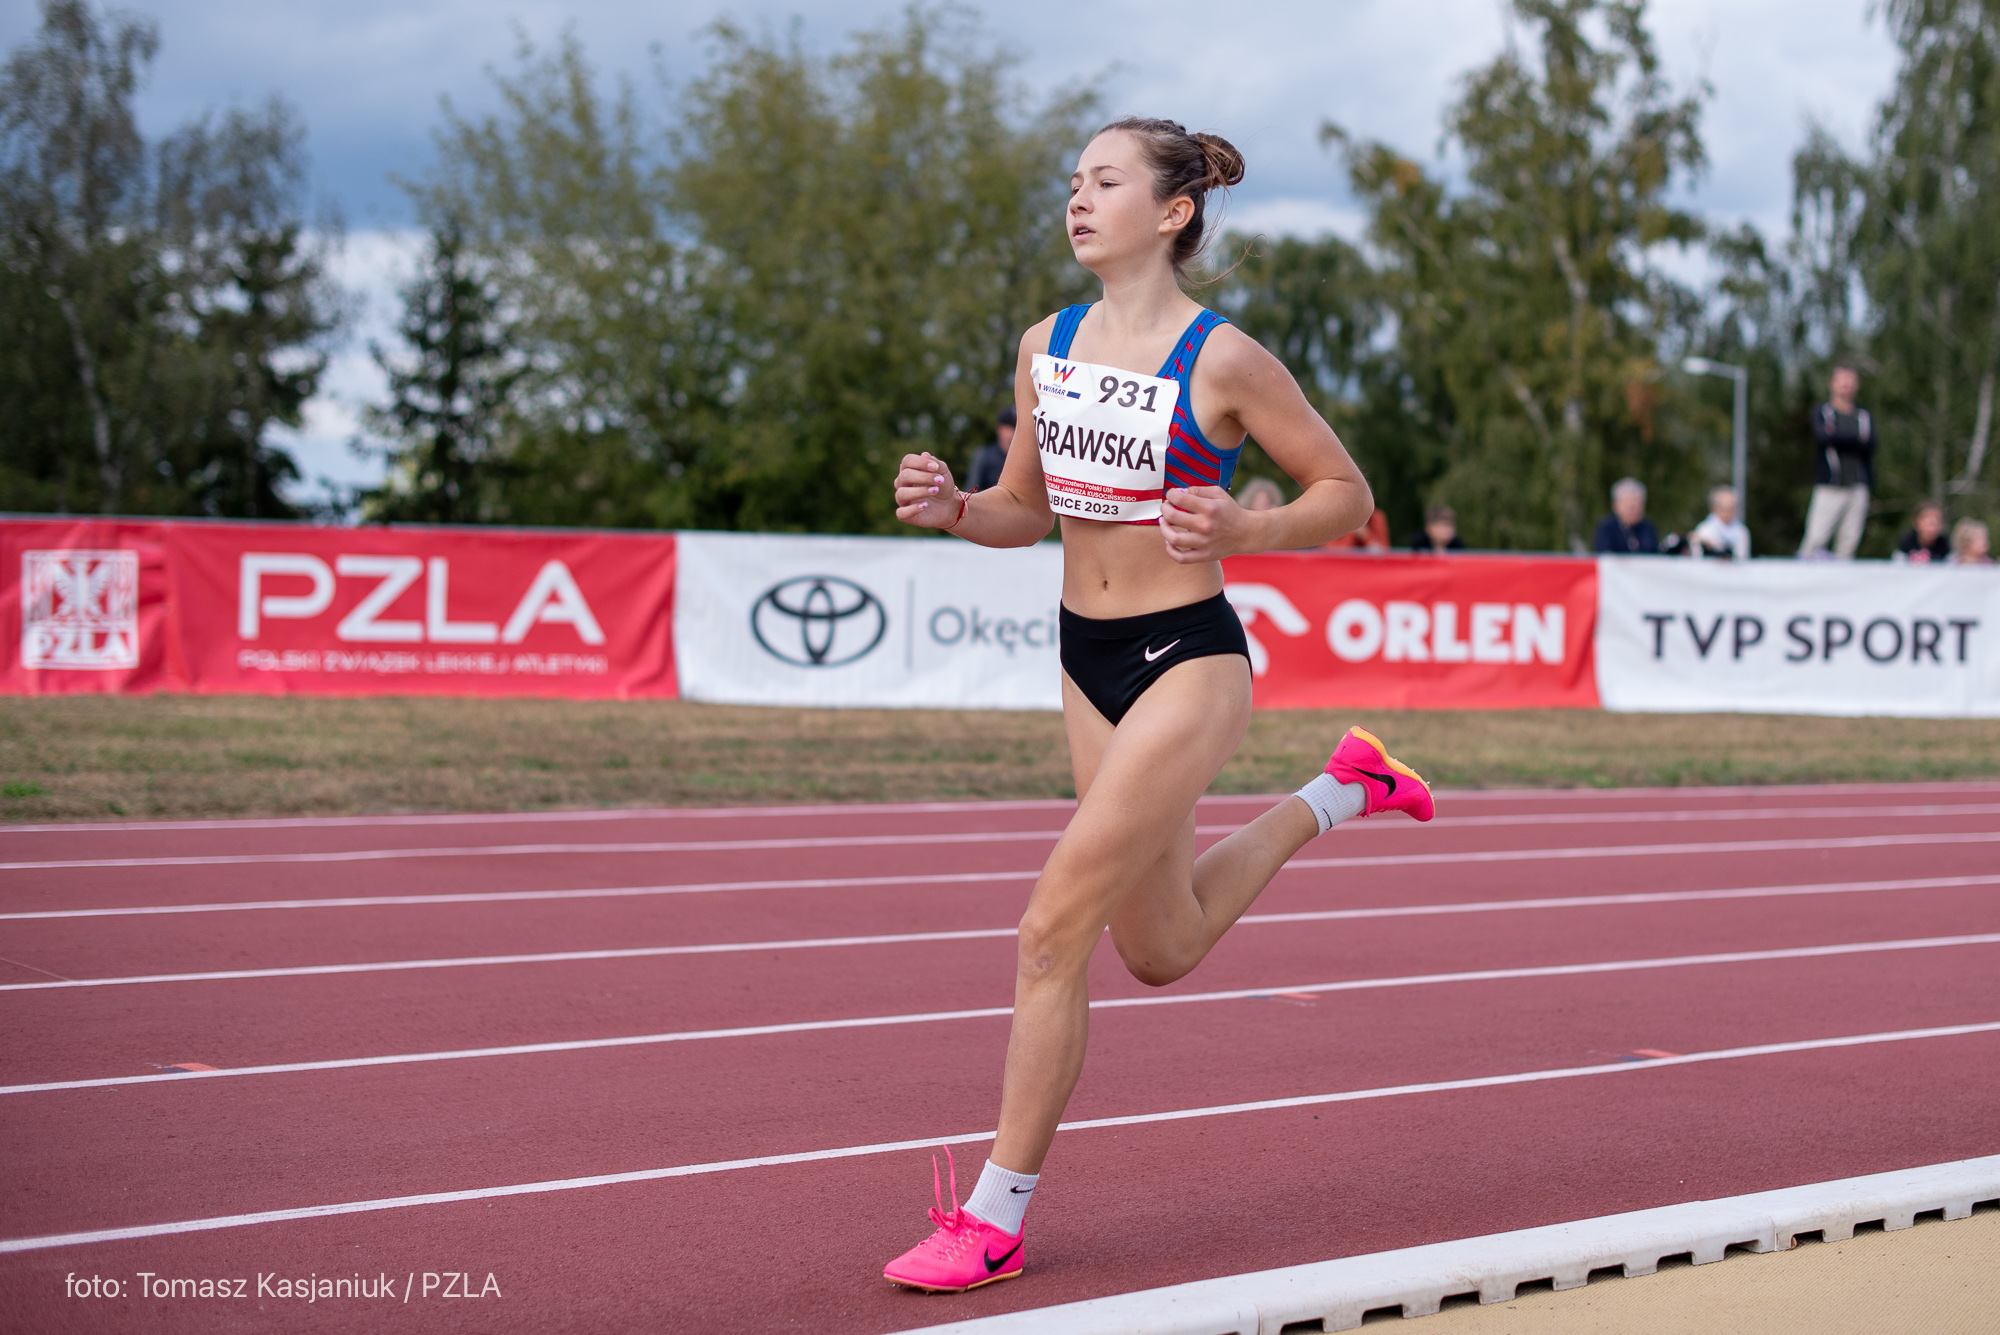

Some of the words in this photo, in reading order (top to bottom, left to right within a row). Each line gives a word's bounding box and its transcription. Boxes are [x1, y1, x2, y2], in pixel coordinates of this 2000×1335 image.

[1043, 384, 1066, 396] WIMAR
[1098, 375, 1159, 413] 931
[1033, 410, 1157, 472] ÓRAWSKA
[1053, 476, 1085, 489] Mistrzostwa
[1085, 483, 1102, 492] Polski
[1061, 485, 1086, 496] JANUSZA
[1087, 490, 1137, 502] KUSOCIŃSKIEGO
[1084, 501, 1119, 515] 2023
[238, 551, 605, 645] PZLA
[28, 627, 129, 660] PZLA
[1326, 598, 1565, 665] ORLEN
[1643, 613, 1765, 662] TVP
[1785, 616, 1980, 665] SPORT
